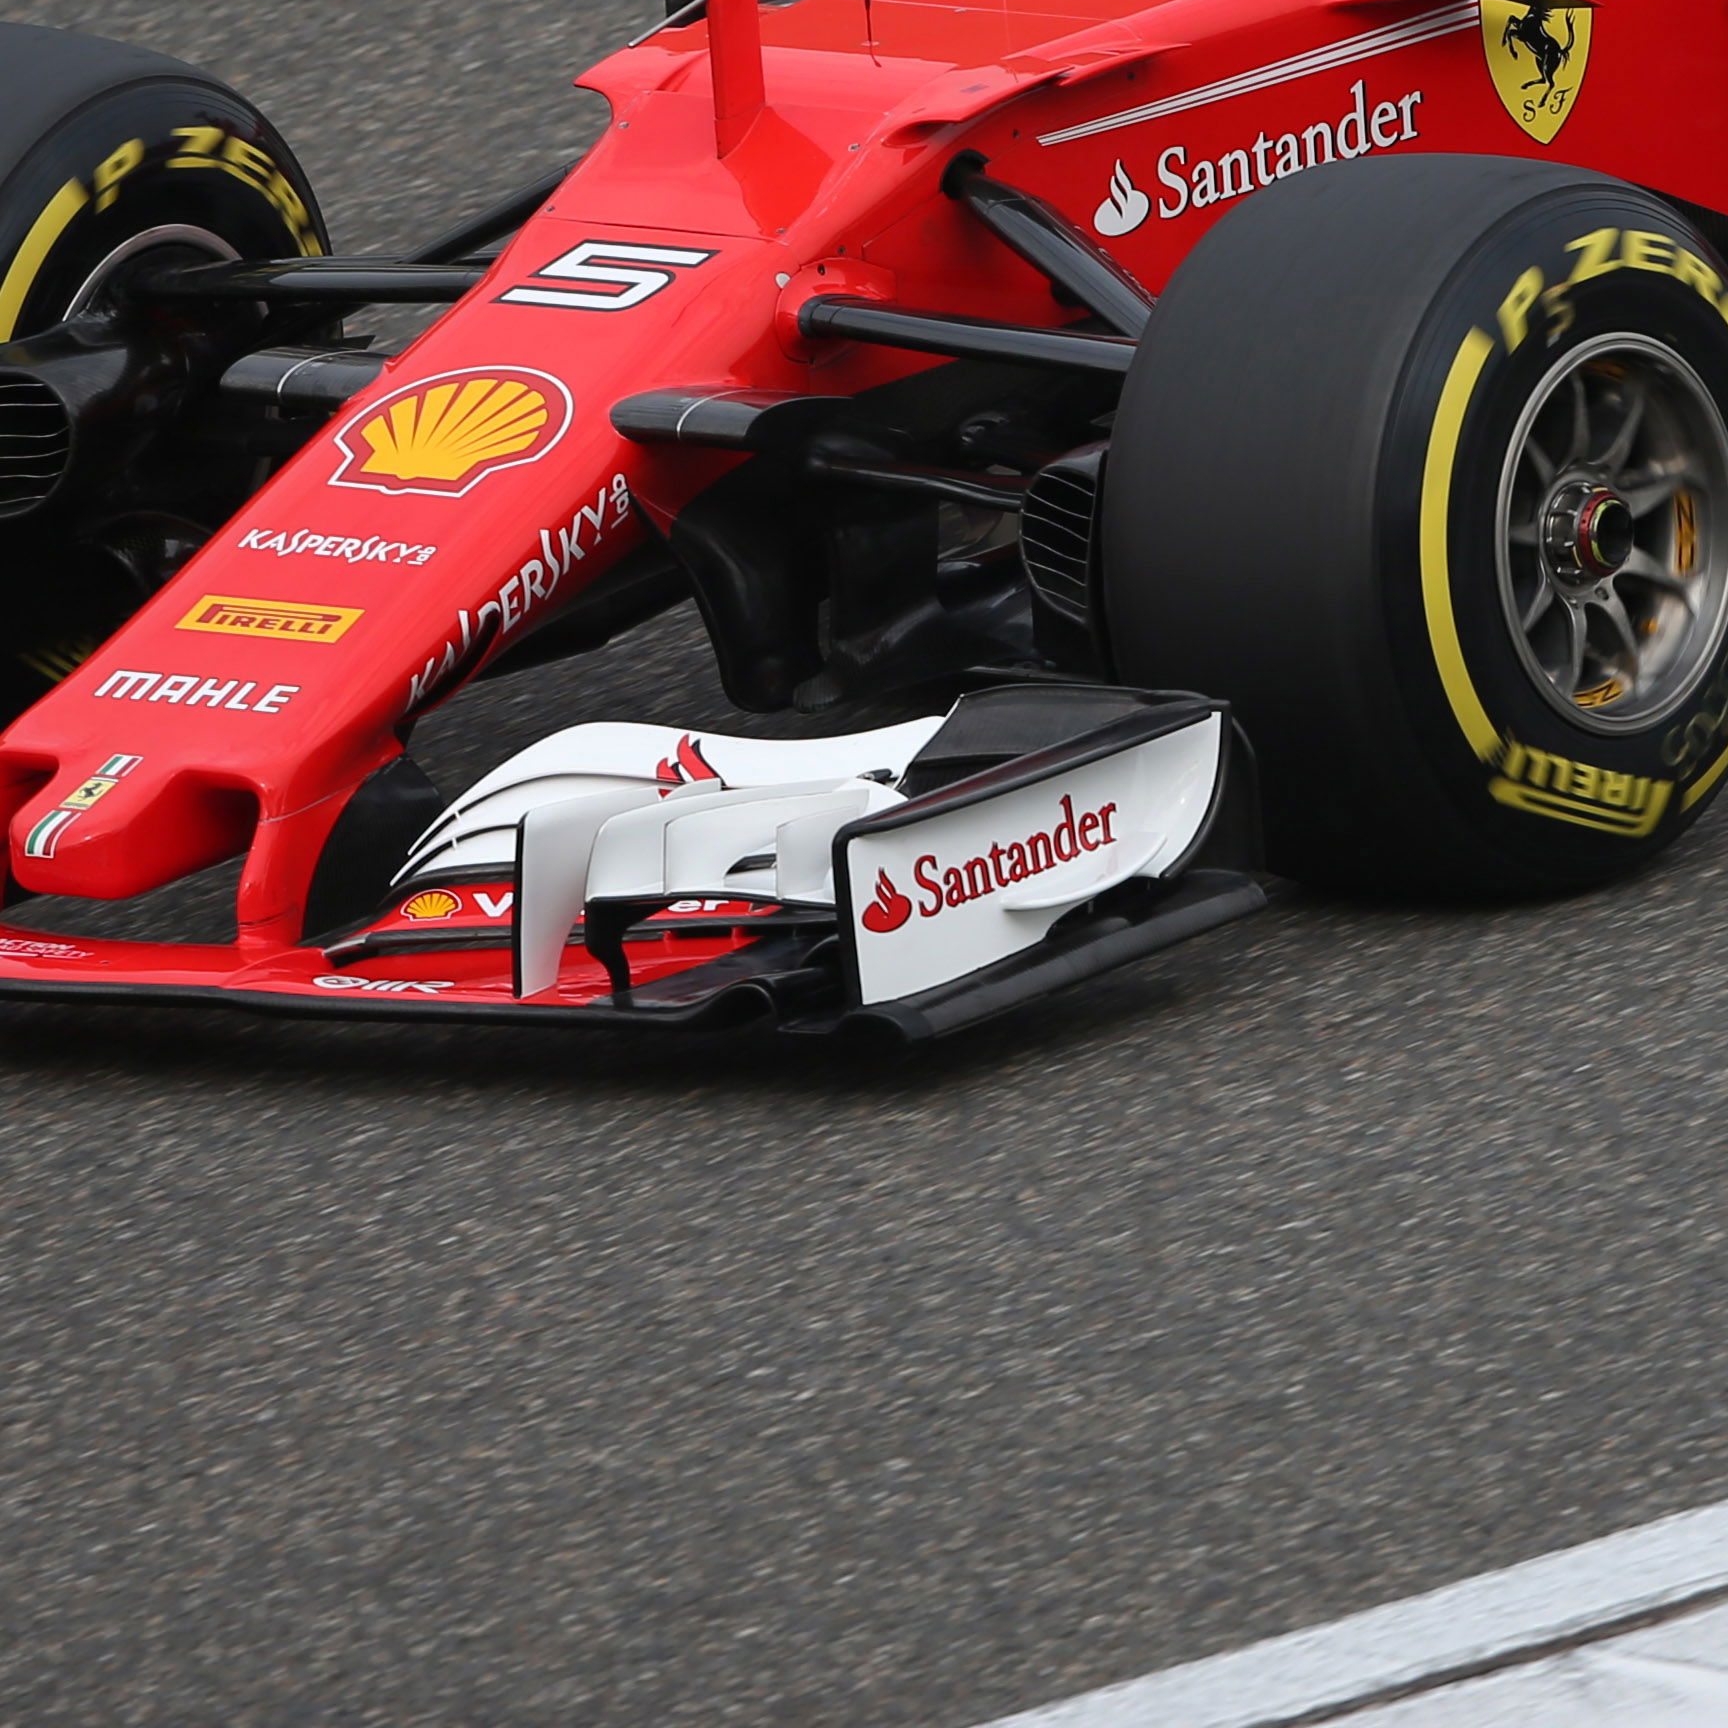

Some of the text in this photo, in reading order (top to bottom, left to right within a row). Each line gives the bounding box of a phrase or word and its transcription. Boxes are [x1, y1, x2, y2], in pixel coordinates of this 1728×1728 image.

[1522, 99, 1536, 123] S
[1158, 80, 1423, 218] Santander
[490, 238, 722, 312] 5
[238, 528, 417, 563] KASPERSKY
[196, 603, 343, 635] PIRELLI
[94, 670, 300, 714] MAHLE
[1488, 742, 1674, 838] PIRELLI
[913, 793, 1117, 919] Santander
